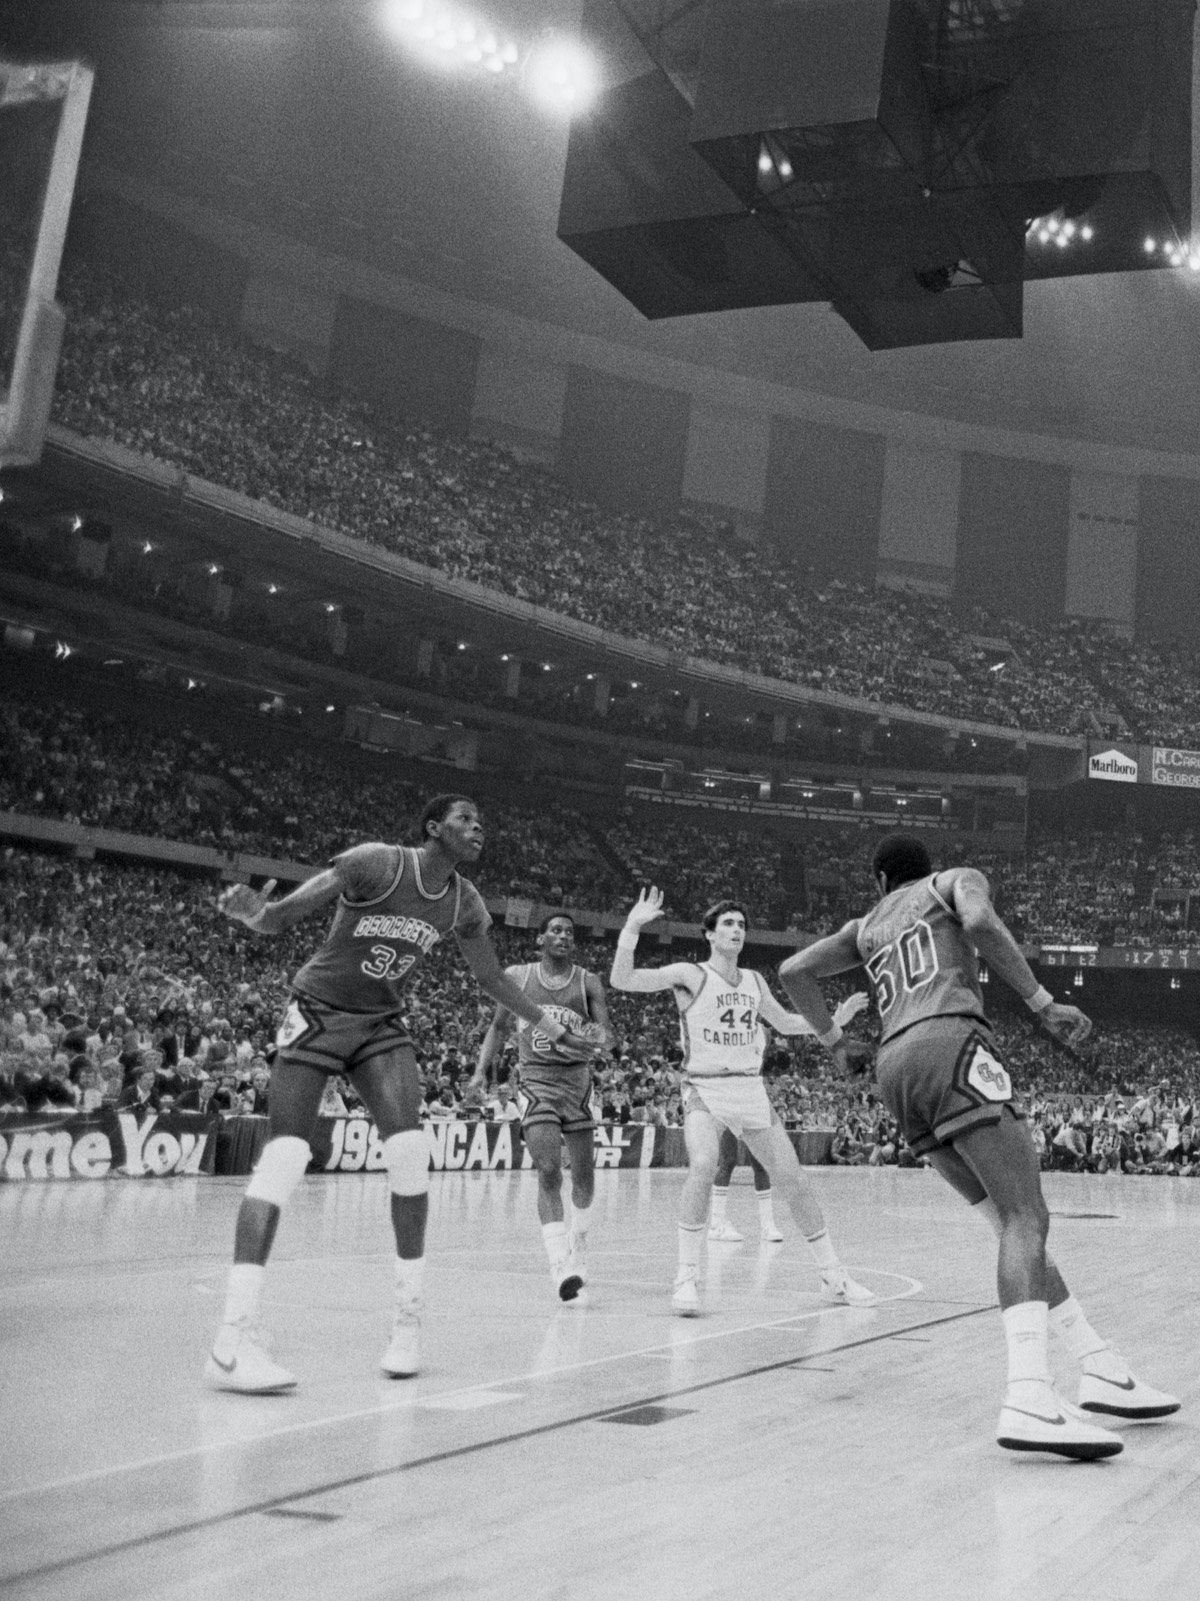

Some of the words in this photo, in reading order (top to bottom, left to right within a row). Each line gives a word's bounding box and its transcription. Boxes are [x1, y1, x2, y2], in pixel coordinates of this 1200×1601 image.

[1091, 758, 1136, 776] Marlboro
[353, 915, 440, 954] GEORGET
[361, 944, 416, 980] 33
[865, 919, 939, 1017] 50
[716, 992, 756, 1010] NORTH
[720, 1009, 753, 1030] 44
[532, 1028, 552, 1052] 2
[703, 1027, 756, 1047] CAROLI
[0, 1131, 113, 1179] me
[117, 1113, 209, 1176] You
[325, 1118, 389, 1171] 198
[423, 1122, 514, 1170] NCAA
